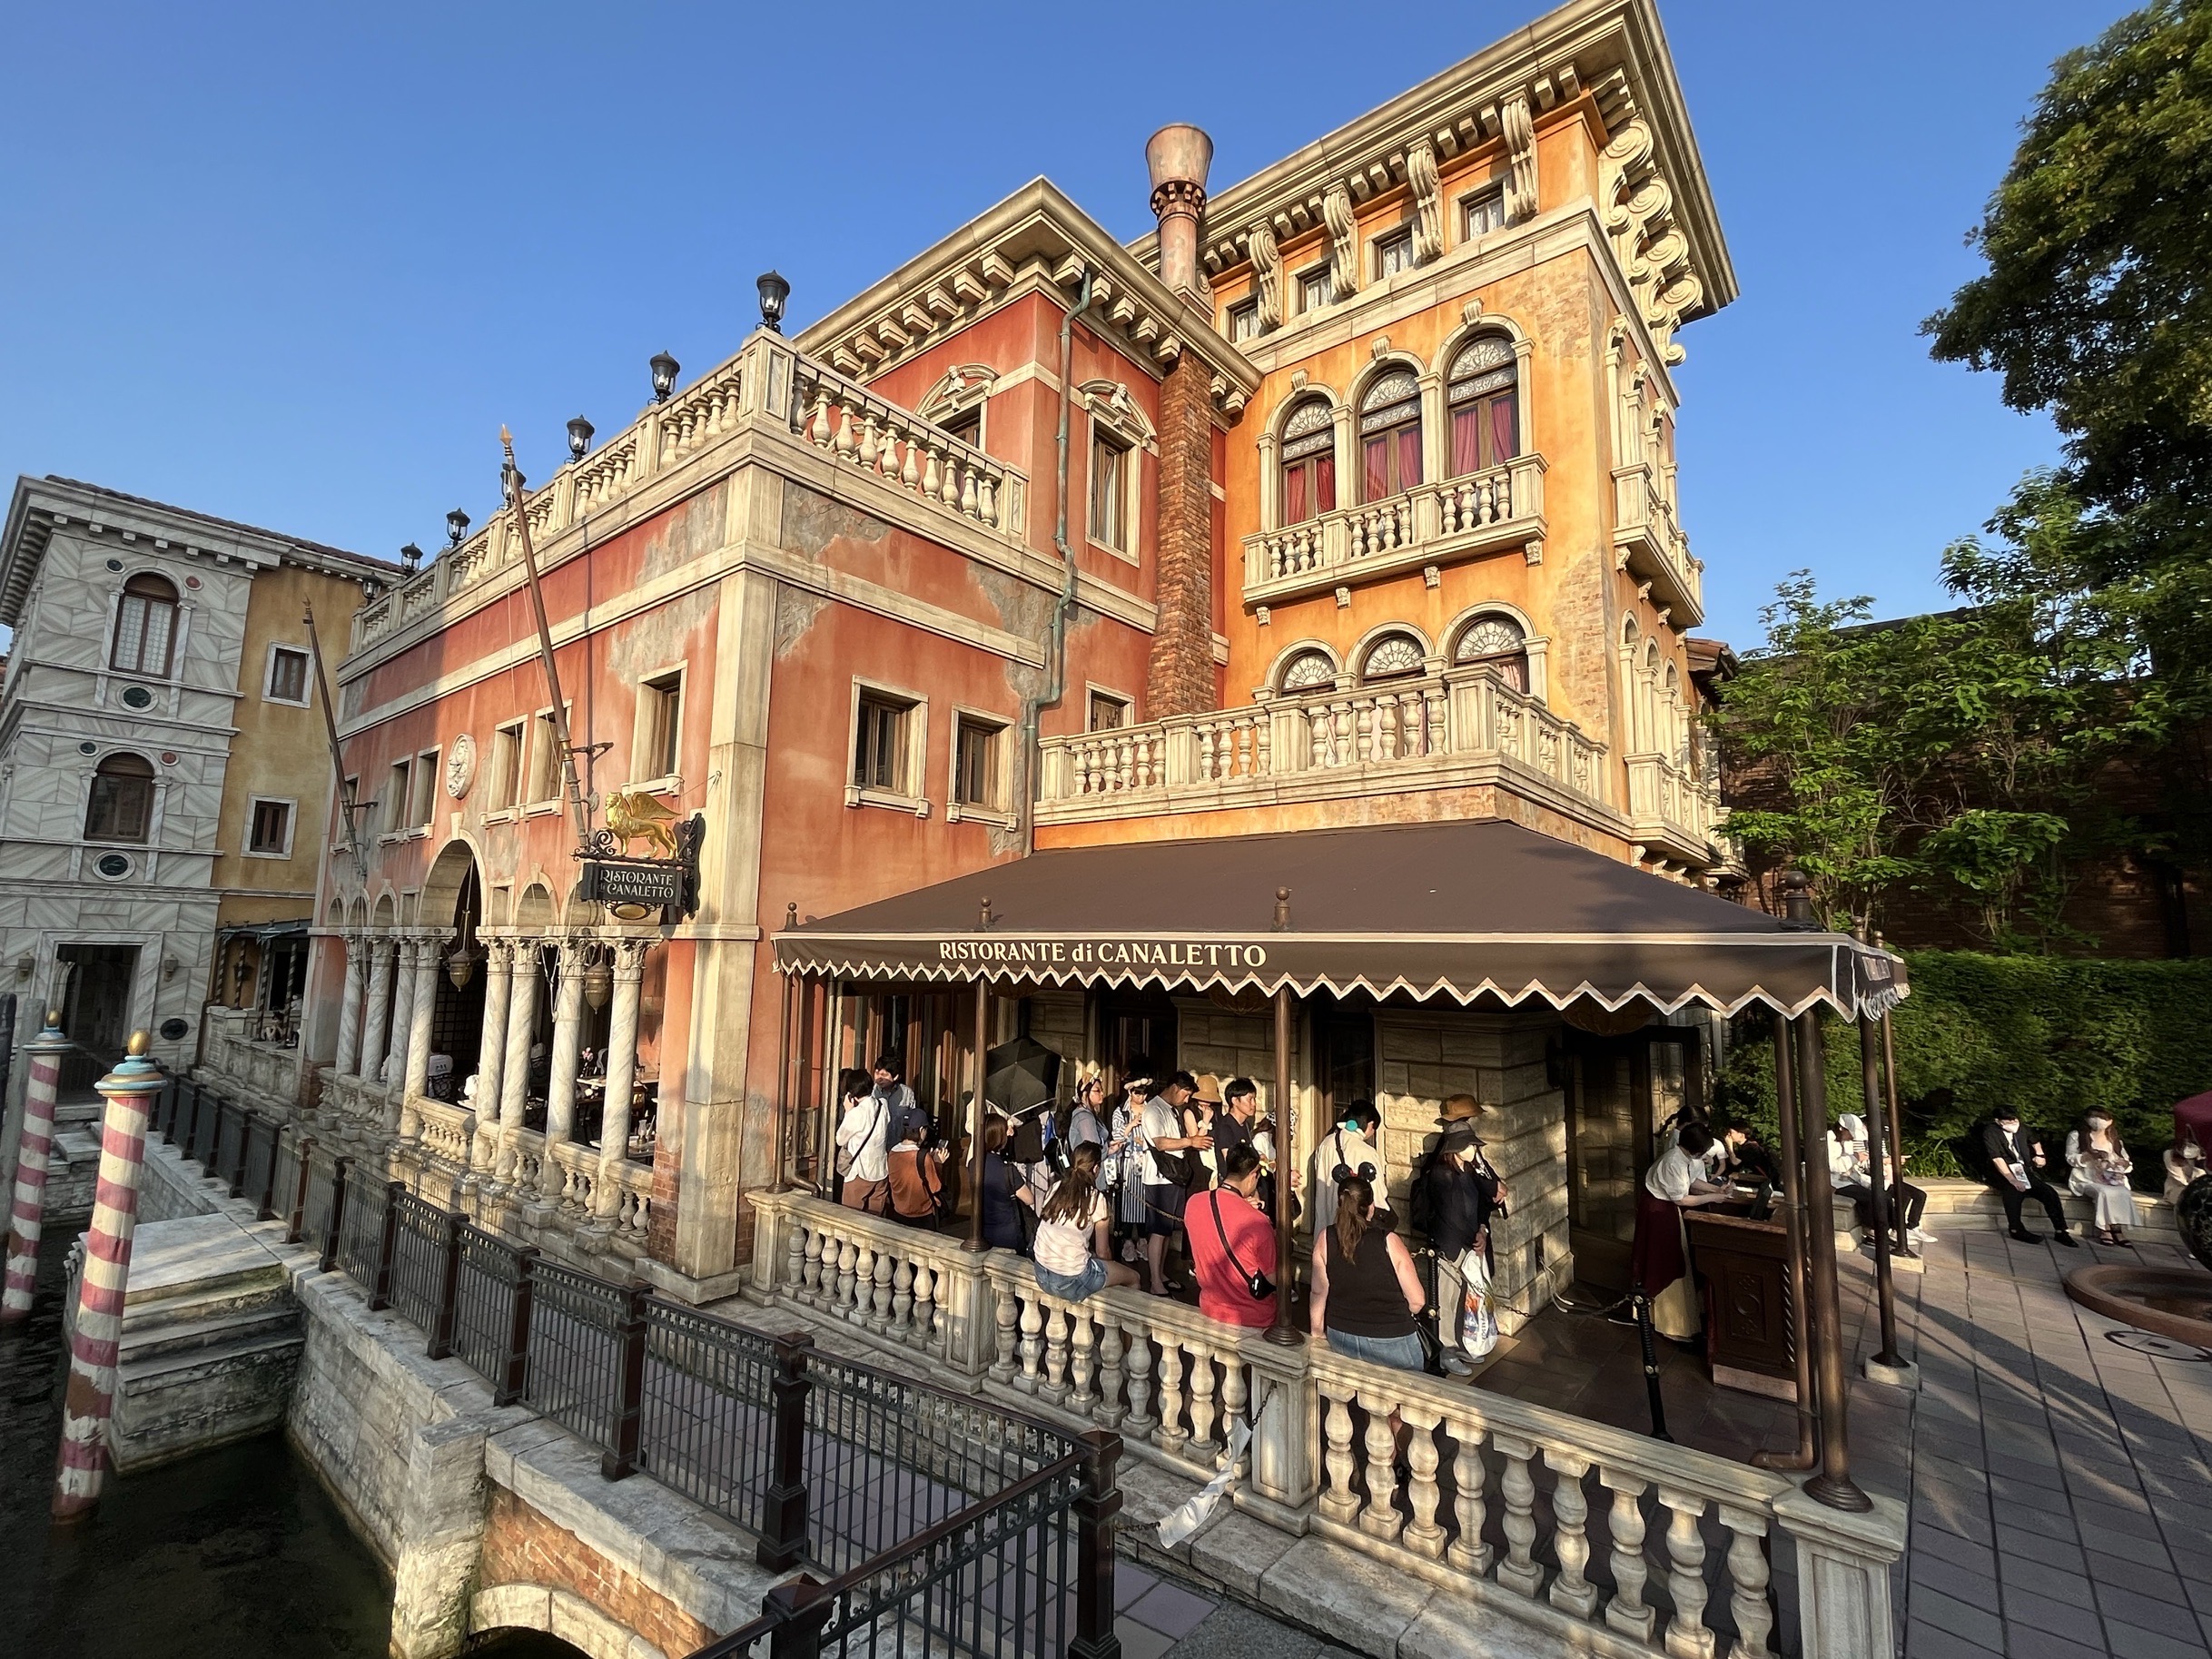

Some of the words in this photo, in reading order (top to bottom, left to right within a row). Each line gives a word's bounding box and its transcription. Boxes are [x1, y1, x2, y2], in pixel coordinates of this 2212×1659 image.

[600, 869, 674, 886] RISTORANTE
[607, 883, 674, 898] CANALETTO
[939, 942, 1066, 962] RISTORANTE
[1071, 943, 1092, 963] di
[1097, 943, 1268, 967] CANALETTO
